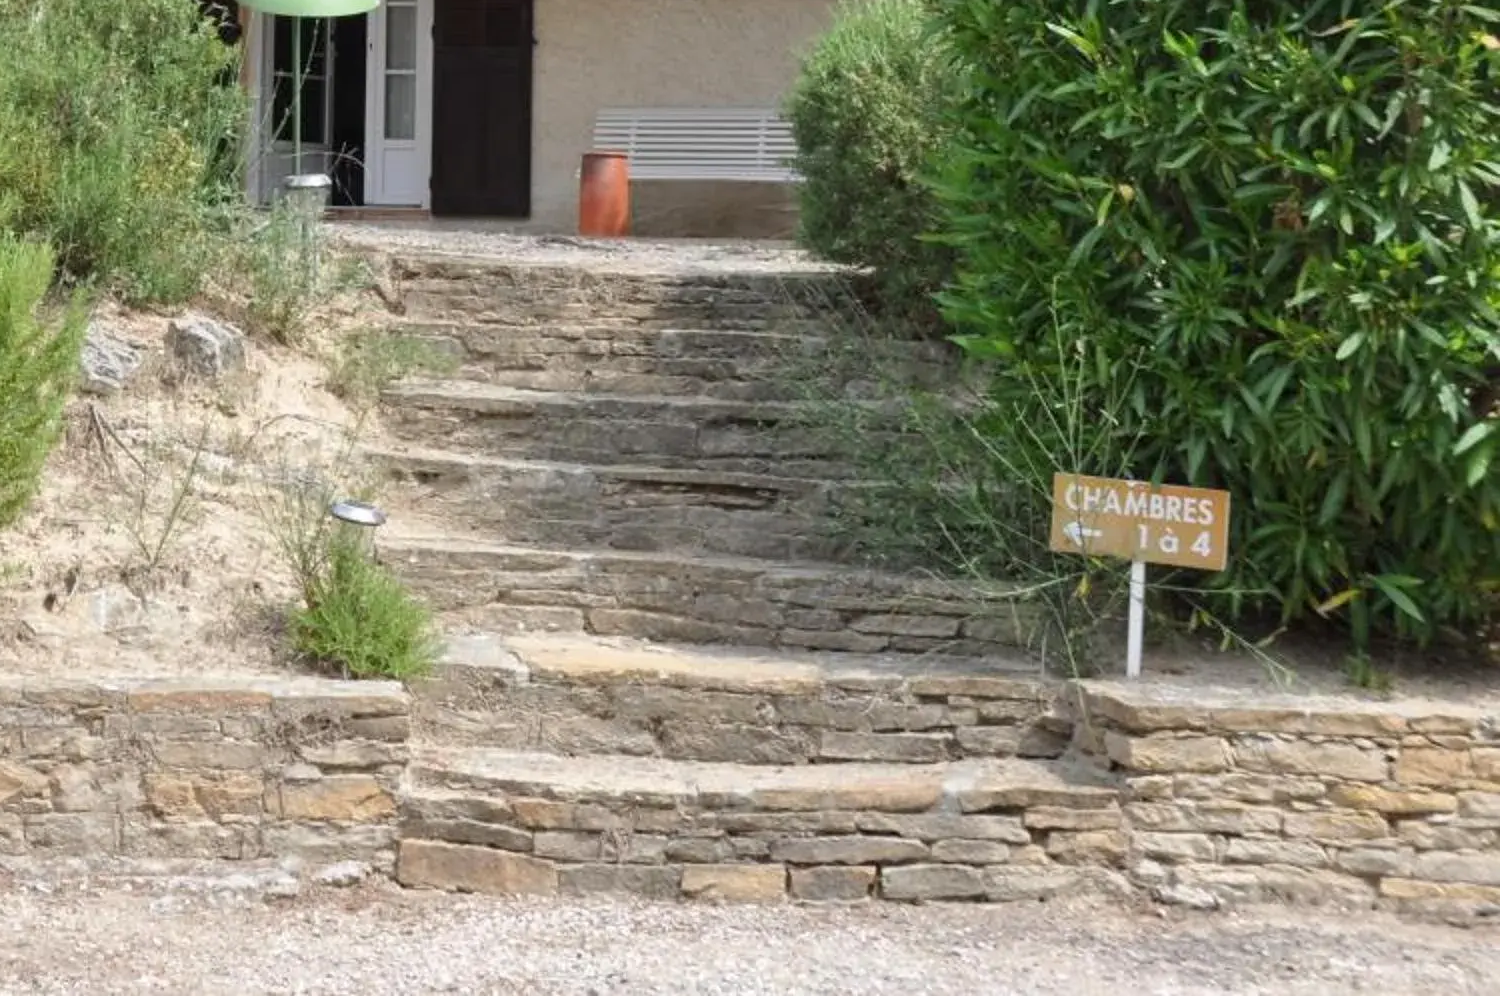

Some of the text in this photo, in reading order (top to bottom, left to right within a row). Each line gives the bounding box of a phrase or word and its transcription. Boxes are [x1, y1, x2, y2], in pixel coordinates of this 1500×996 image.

[1065, 483, 1214, 525] CHAMBRES
[1137, 524, 1212, 557] 1 à 4
